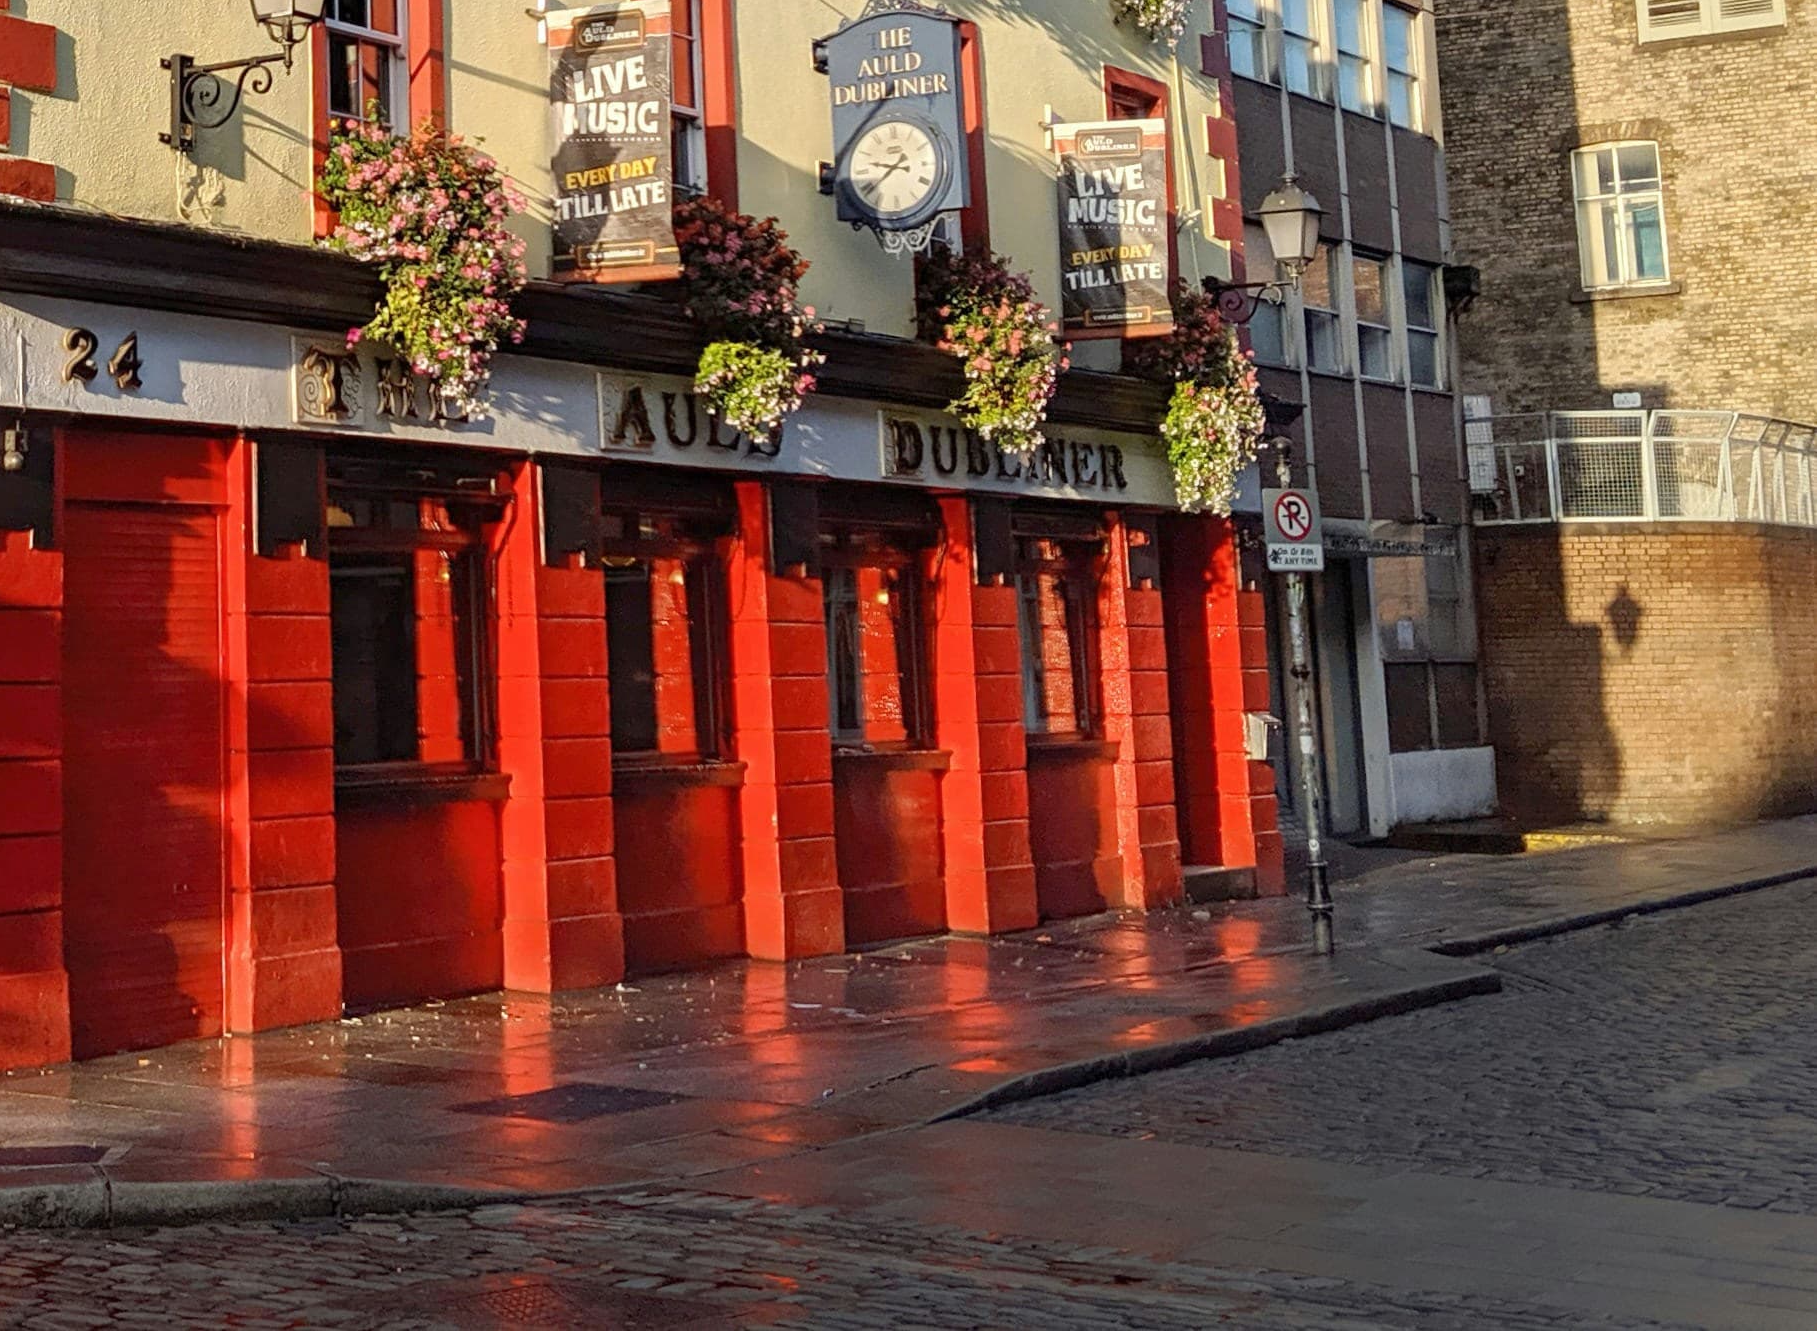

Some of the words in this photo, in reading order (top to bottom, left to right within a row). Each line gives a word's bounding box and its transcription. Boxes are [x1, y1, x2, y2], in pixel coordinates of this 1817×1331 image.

[573, 55, 648, 104] LIVE
[857, 52, 922, 78] AULD
[834, 73, 949, 106] DUBLINER
[560, 100, 659, 136] MUSIC
[565, 164, 616, 190] EVERY
[620, 156, 658, 179] DAY
[1075, 163, 1145, 198] LIVE
[556, 193, 609, 222] TILL
[609, 181, 667, 214] LATE
[1068, 198, 1156, 226] MUSIC
[1071, 245, 1117, 266] EVERY
[1119, 243, 1154, 260] DAY
[1066, 268, 1111, 290] TILL
[1111, 262, 1163, 284] LATE
[62, 326, 144, 390] 24
